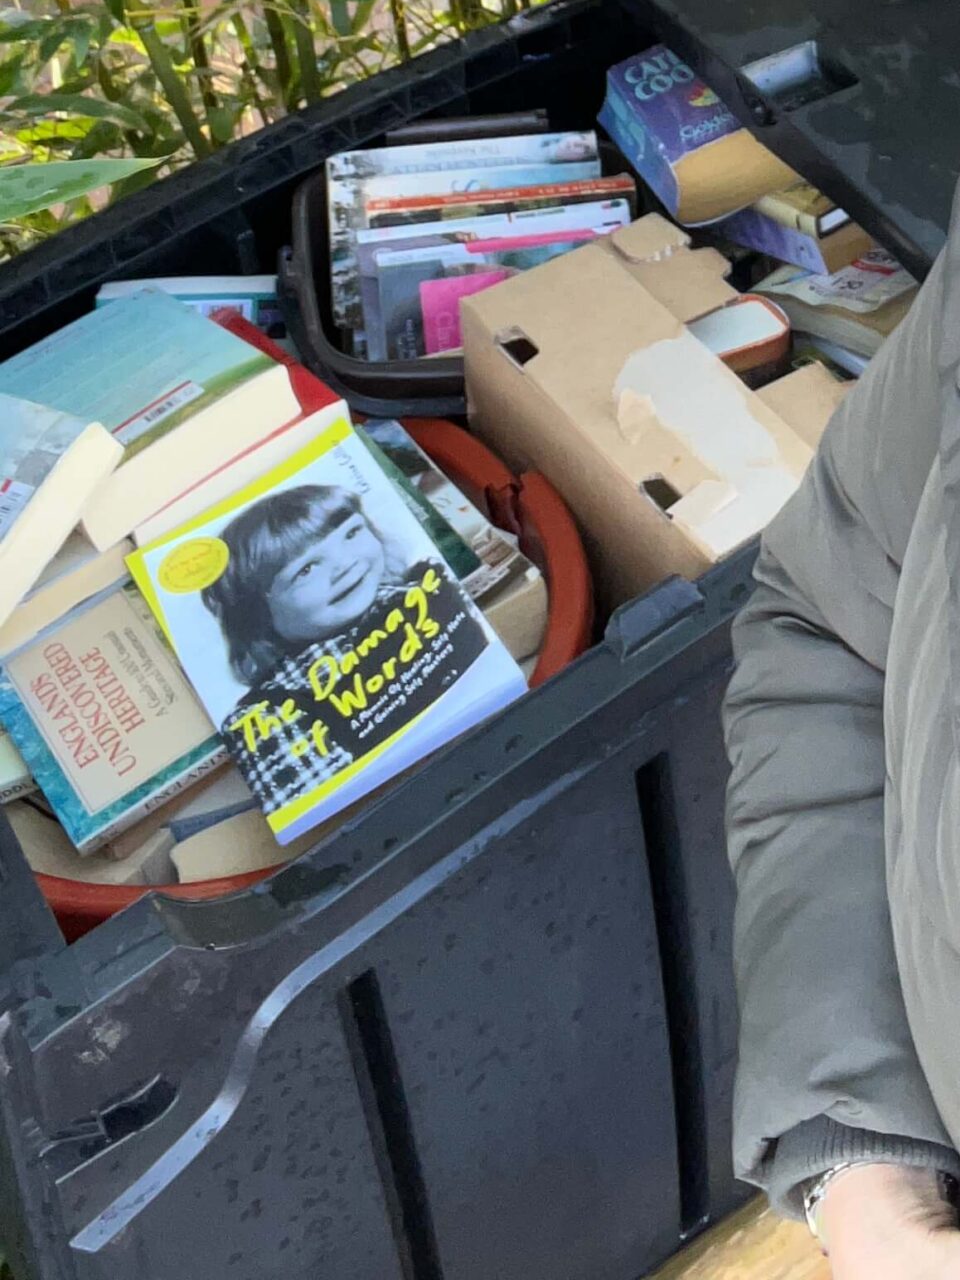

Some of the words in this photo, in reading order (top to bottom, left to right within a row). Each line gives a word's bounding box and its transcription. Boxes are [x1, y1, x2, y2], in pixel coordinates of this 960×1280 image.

[43, 642, 137, 777] UNDISCOVERED
[79, 647, 146, 734] HERITAGE
[229, 698, 303, 753] The
[307, 569, 441, 701] Damage
[290, 720, 329, 757] of
[329, 618, 441, 718] Words
